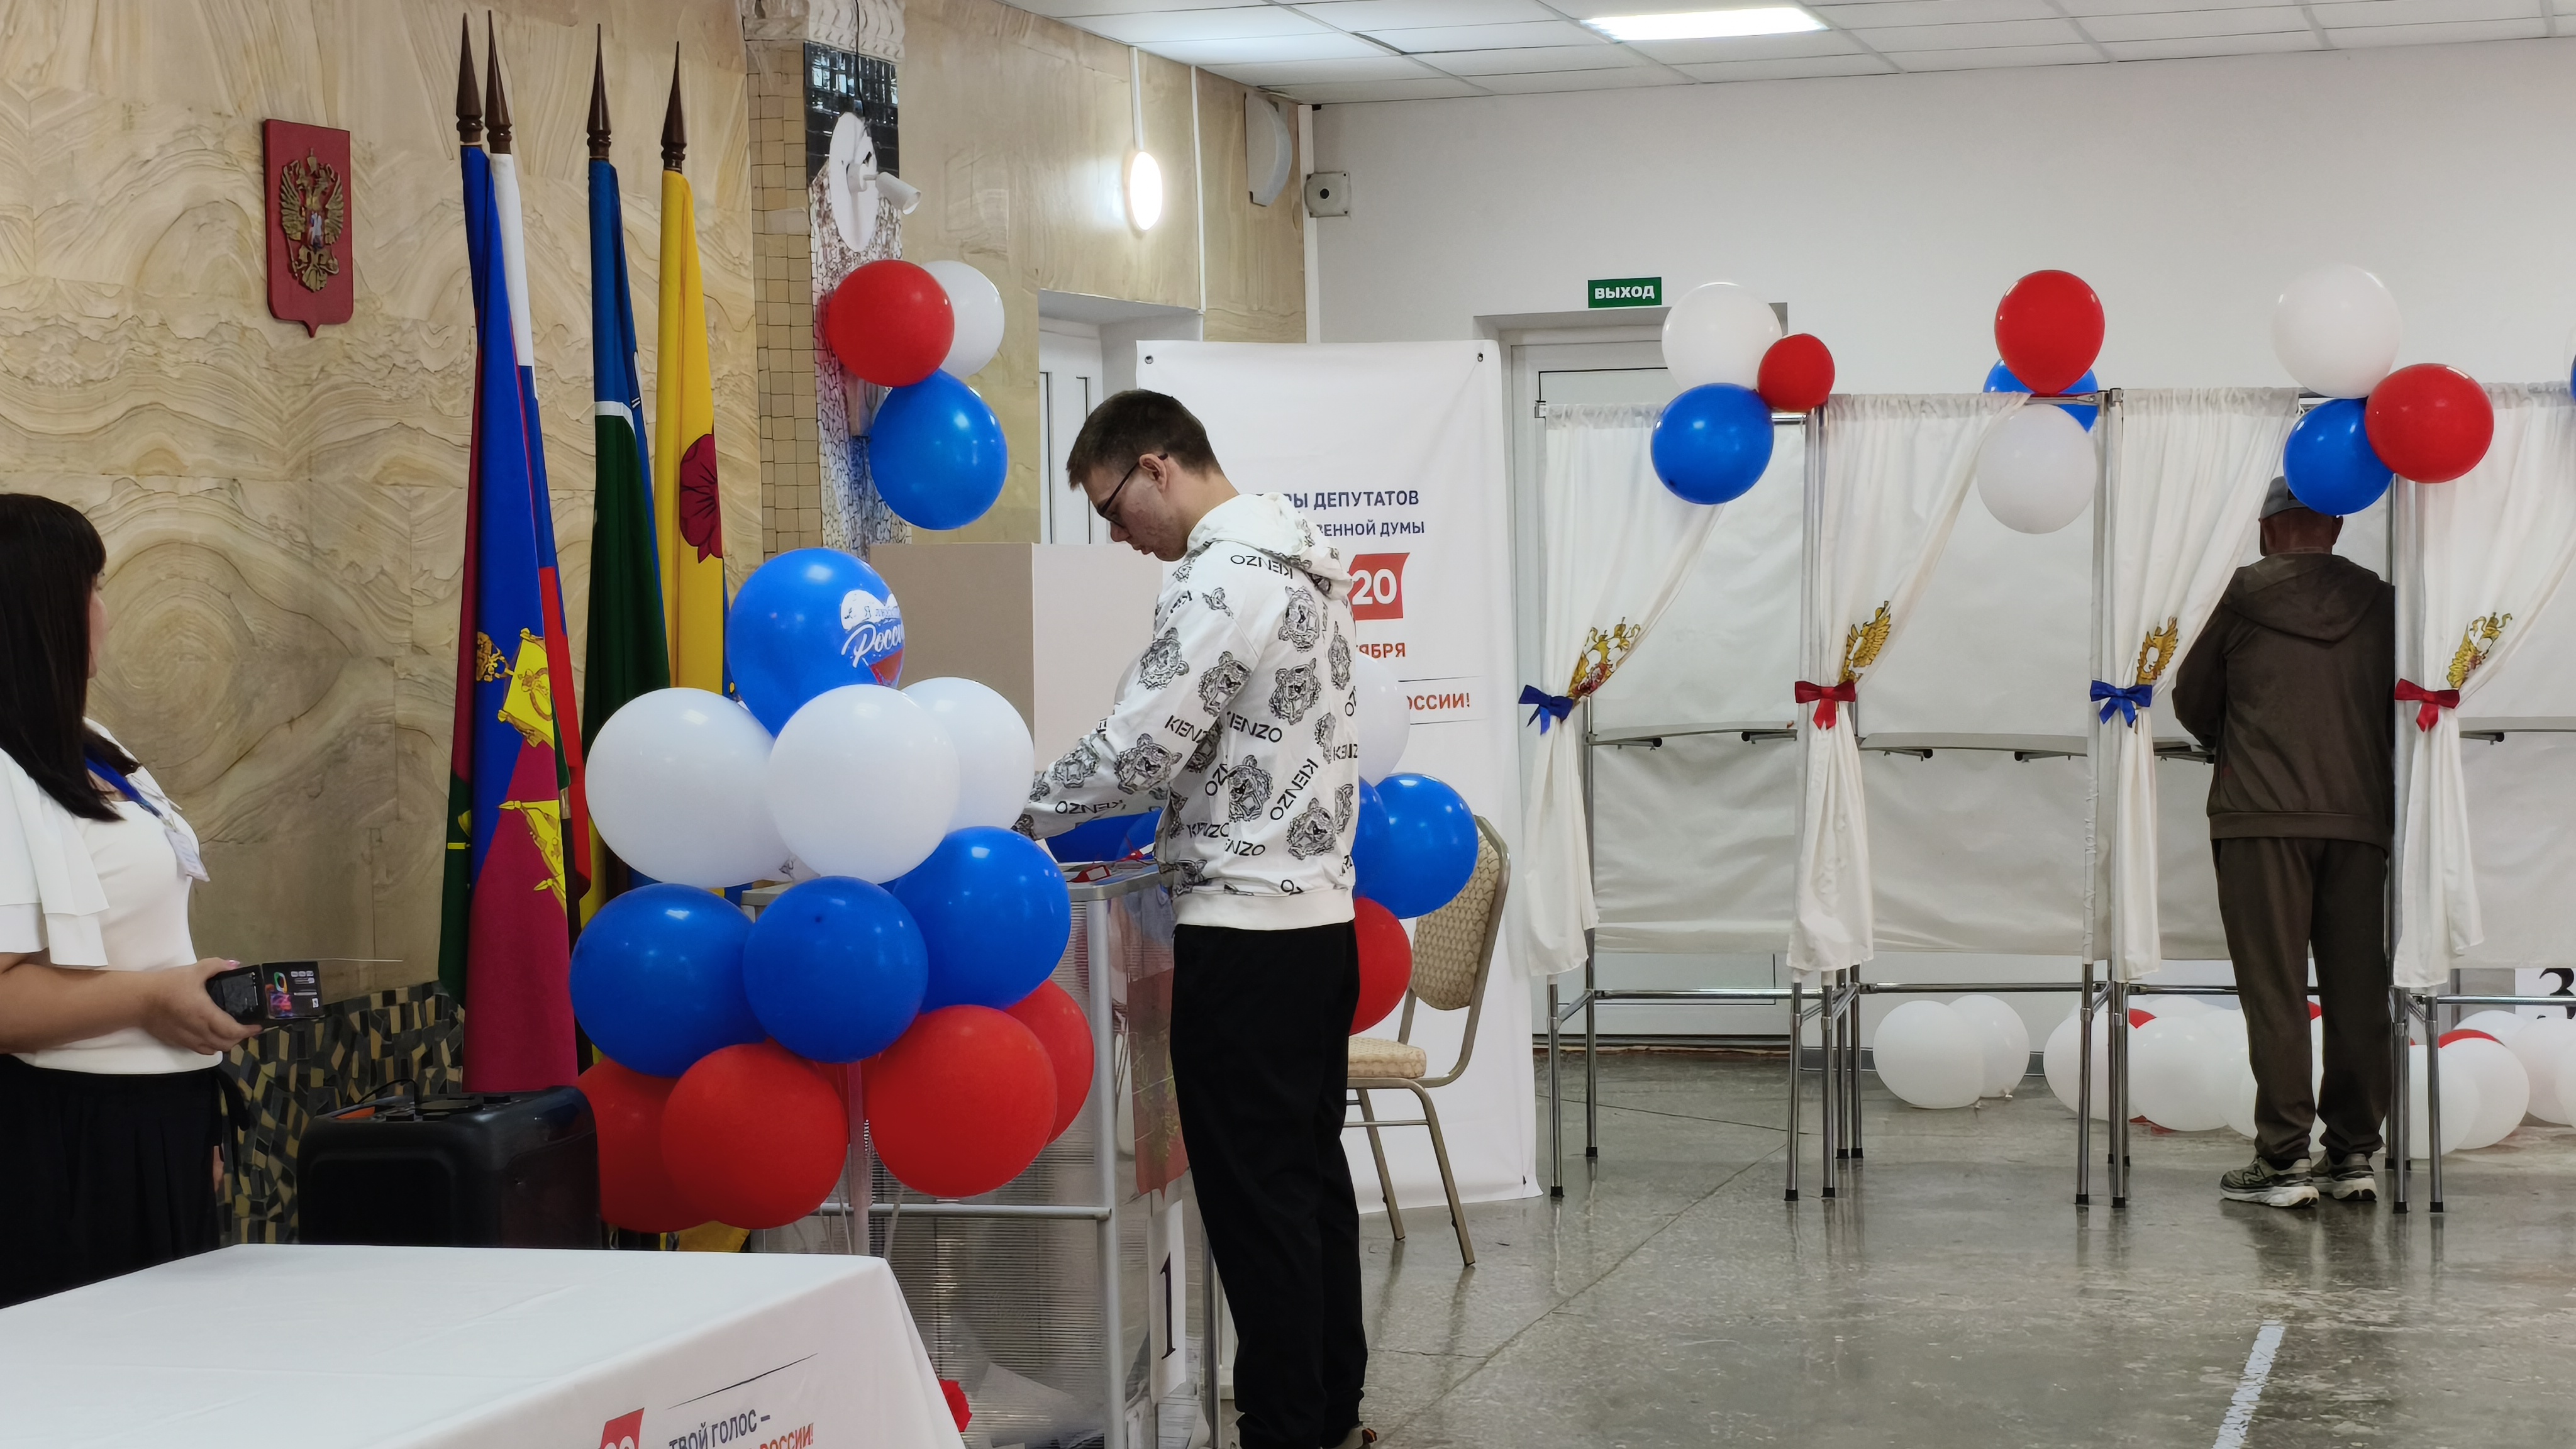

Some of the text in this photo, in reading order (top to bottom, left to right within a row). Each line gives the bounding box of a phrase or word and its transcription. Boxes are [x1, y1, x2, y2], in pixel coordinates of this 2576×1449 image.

[1594, 286, 1655, 299] ВЫХОД
[1313, 491, 1419, 510] ДЕПУТАТОВ
[1380, 521, 1425, 537] ДУМЫ
[1230, 555, 1294, 579] KENZO
[1351, 569, 1397, 605] 20
[1227, 711, 1282, 743] ENZO
[1270, 758, 1319, 821] KENZO
[1224, 838, 1265, 856] NZO
[1160, 1251, 1176, 1360] 1
[711, 1409, 757, 1448] ГОЛОС
